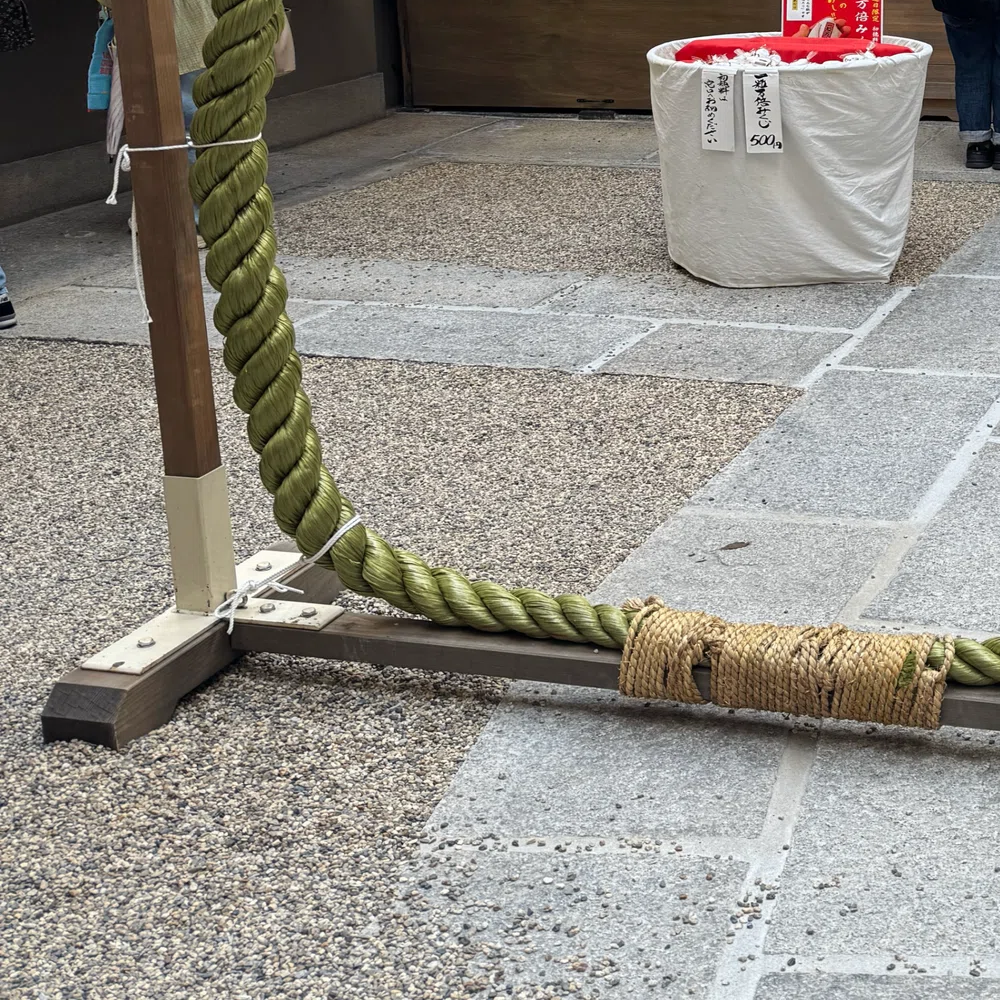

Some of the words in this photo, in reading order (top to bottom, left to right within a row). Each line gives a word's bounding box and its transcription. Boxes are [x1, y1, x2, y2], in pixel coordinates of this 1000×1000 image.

[752, 73, 772, 129] 一粒万倍みくじ
[750, 134, 782, 149] 500円
